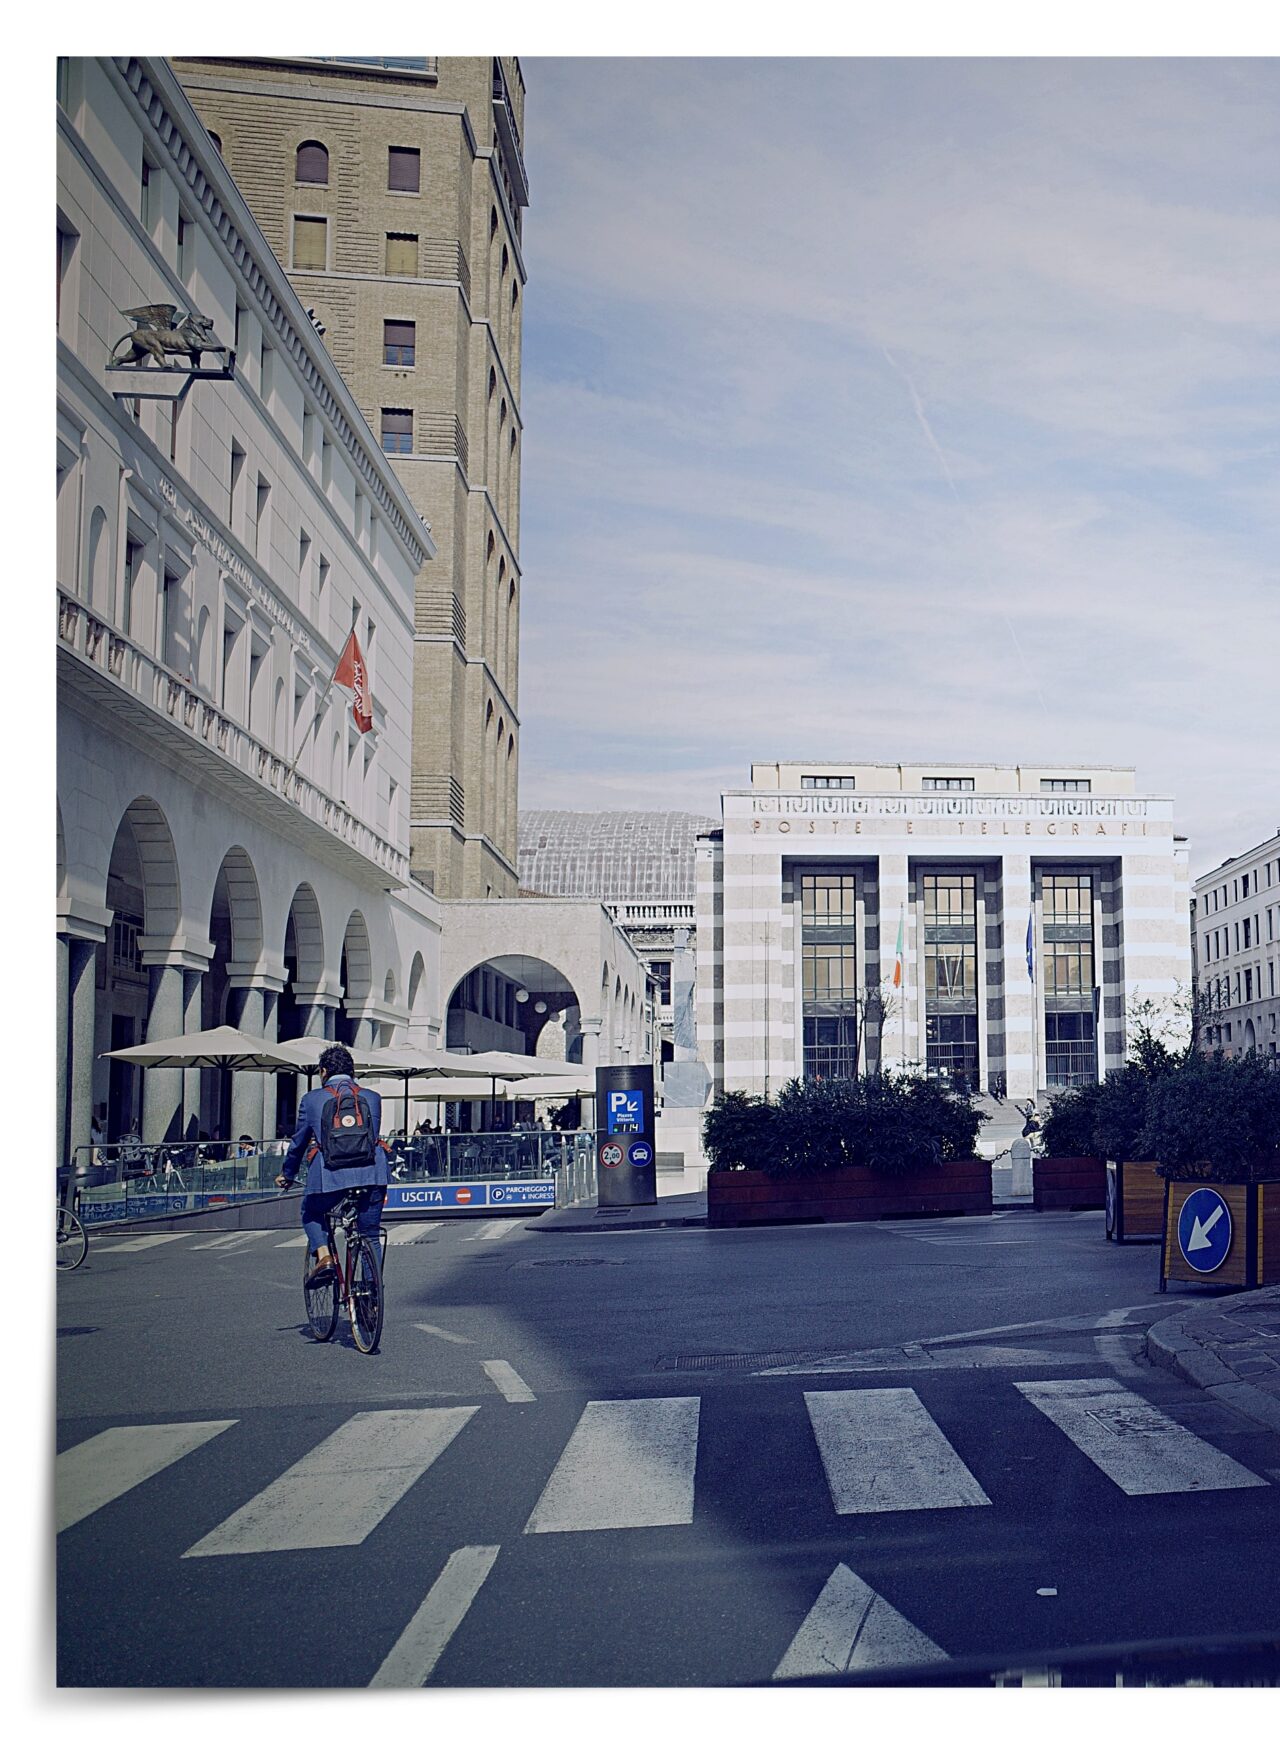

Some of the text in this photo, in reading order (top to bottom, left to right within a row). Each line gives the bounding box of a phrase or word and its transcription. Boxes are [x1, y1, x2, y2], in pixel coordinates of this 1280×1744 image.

[753, 820, 1147, 836] POSTE E TELEGRAFI
[611, 1092, 627, 1112] P
[505, 1185, 547, 1193] PARCHEGGIO
[401, 1190, 443, 1203] USCITA
